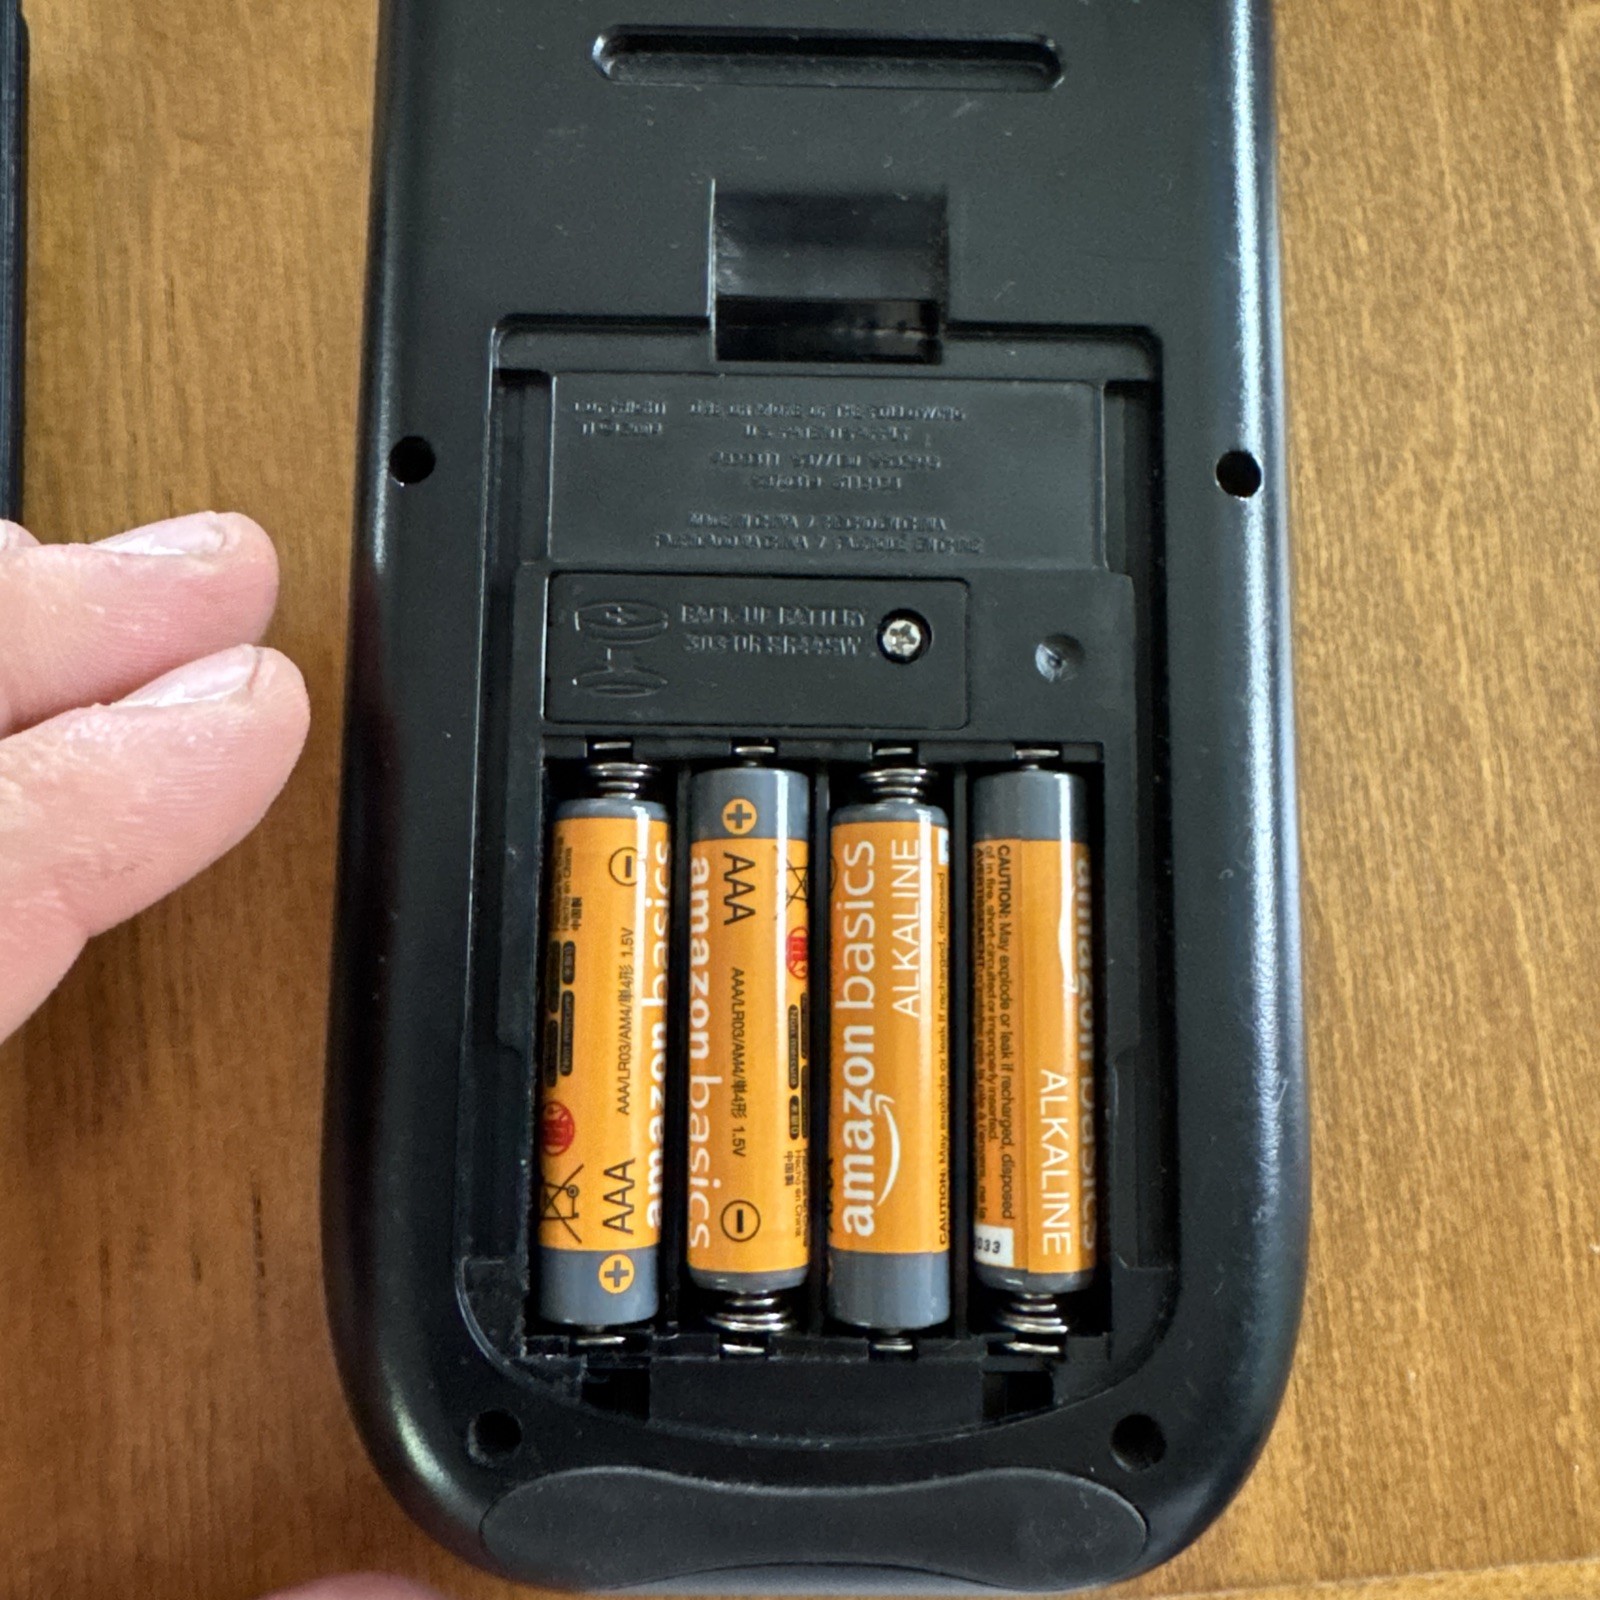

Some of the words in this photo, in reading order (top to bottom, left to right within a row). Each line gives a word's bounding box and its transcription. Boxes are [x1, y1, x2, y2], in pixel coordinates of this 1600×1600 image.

[723, 852, 757, 926] AAA
[998, 844, 1012, 918] CAUTION:
[620, 927, 635, 958] 1.5V
[642, 840, 670, 1007] basics
[690, 857, 710, 1059] amazon
[834, 840, 876, 1010] basics
[891, 838, 921, 1019] ALKALINE
[997, 922, 1013, 951] May
[998, 956, 1013, 1010] explode
[1000, 1013, 1011, 1028] or
[1001, 1031, 1014, 1059] leak
[1001, 1063, 1014, 1072] if
[646, 1020, 667, 1229] amazon
[731, 1125, 746, 1157] 1.5V
[842, 1025, 876, 1237] amazon
[999, 1075, 1015, 1150] recharged,
[602, 1157, 636, 1235] AAA
[689, 1076, 723, 1248] basics
[1001, 1153, 1015, 1220] disposed
[1040, 1069, 1072, 1256] ALKALINE
